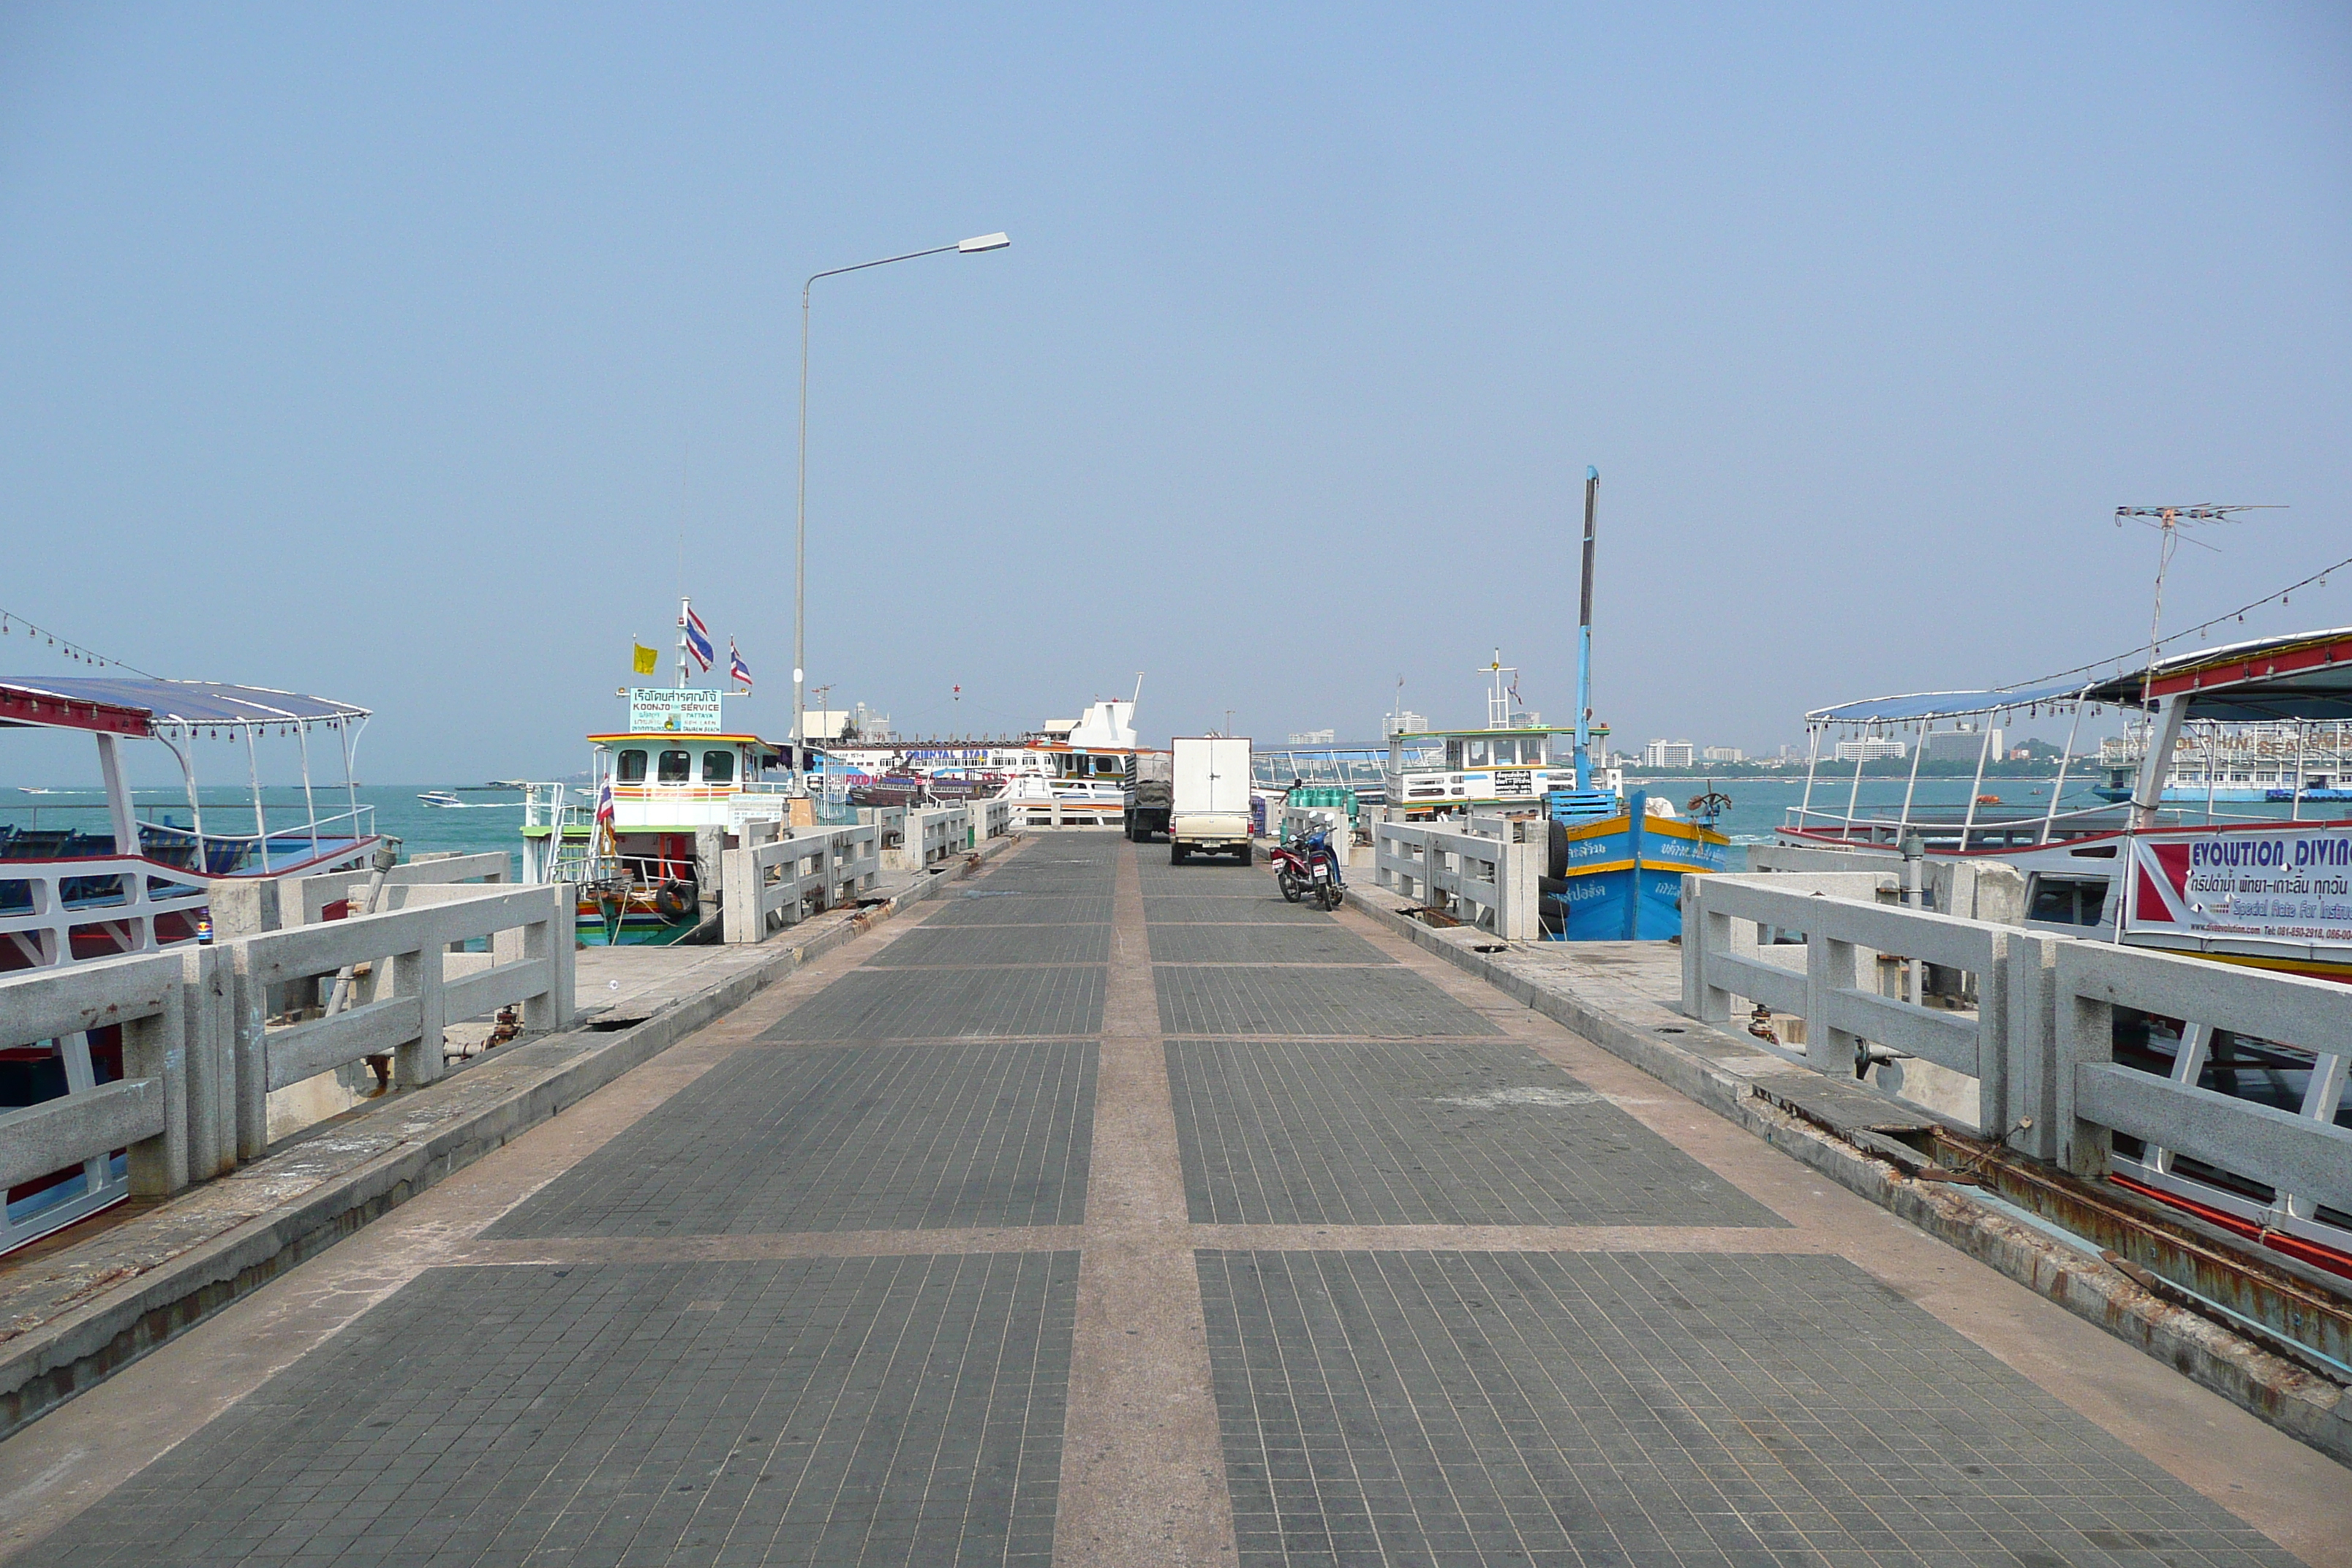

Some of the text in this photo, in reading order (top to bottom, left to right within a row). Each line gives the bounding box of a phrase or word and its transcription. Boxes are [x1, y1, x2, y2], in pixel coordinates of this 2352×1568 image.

[681, 704, 720, 712] SERVICE
[2176, 731, 2352, 755] OLPHIN SEAOOD
[905, 750, 955, 759] ORIENTAL
[962, 750, 989, 759] STAR
[2193, 839, 2352, 867] EVOLUTION DIVIN
[2313, 875, 2348, 900] ทุกวัน
[2234, 898, 2267, 919] Special
[2272, 899, 2296, 917] Rate
[2264, 925, 2276, 935] Tel:
